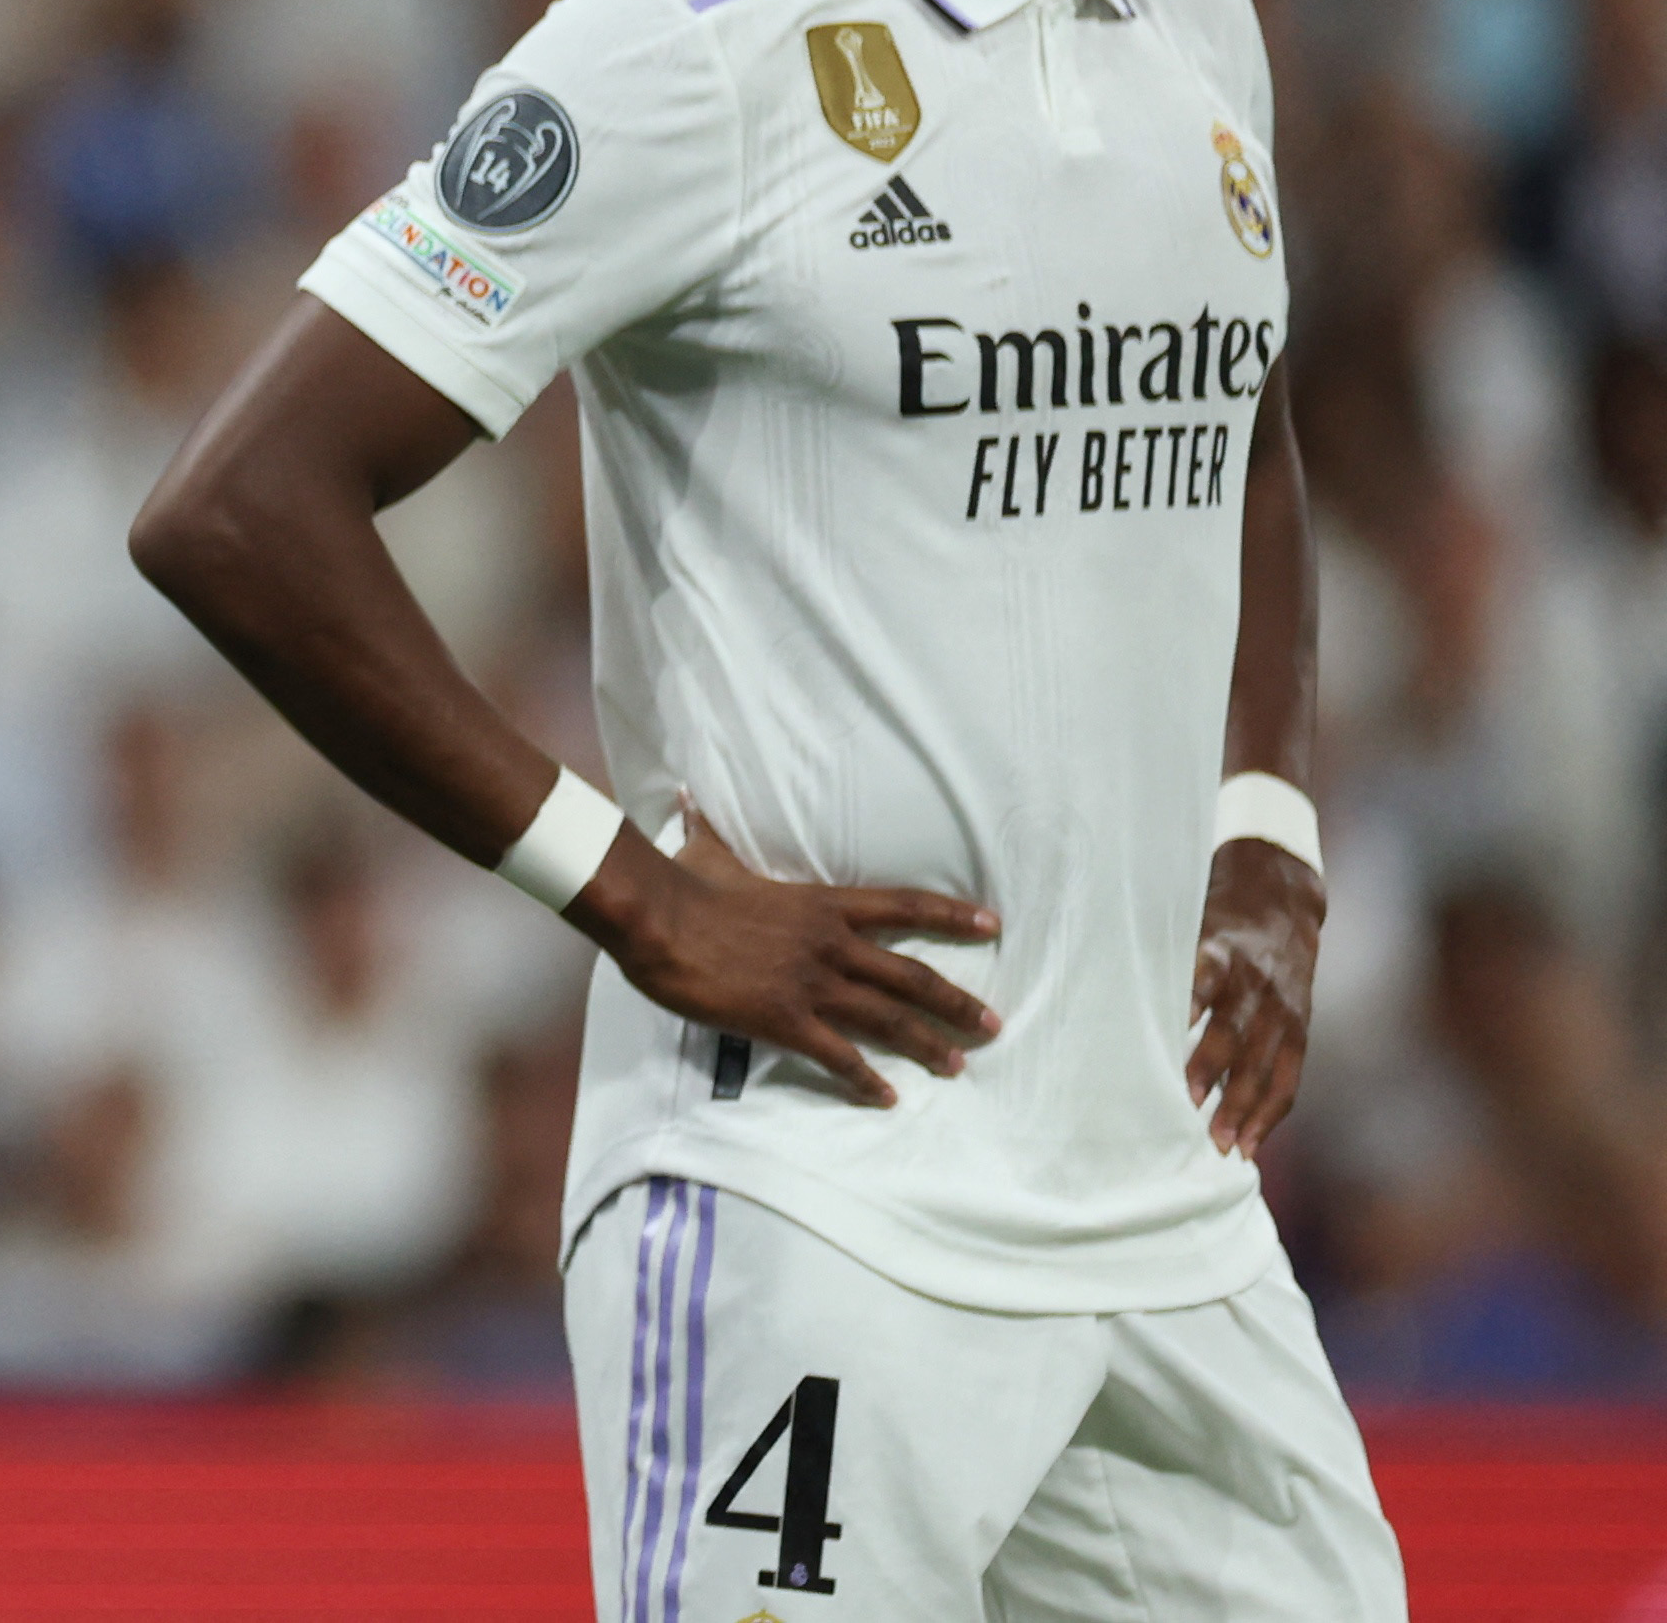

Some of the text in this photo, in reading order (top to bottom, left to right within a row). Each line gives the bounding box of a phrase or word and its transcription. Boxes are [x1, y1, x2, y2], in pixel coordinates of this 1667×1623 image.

[851, 107, 900, 131] FIFA
[468, 149, 512, 194] 14
[849, 219, 952, 250] adidas
[890, 301, 1275, 418] Emirates
[966, 423, 1229, 520] FLY BETTER
[704, 1374, 843, 1597] 4
